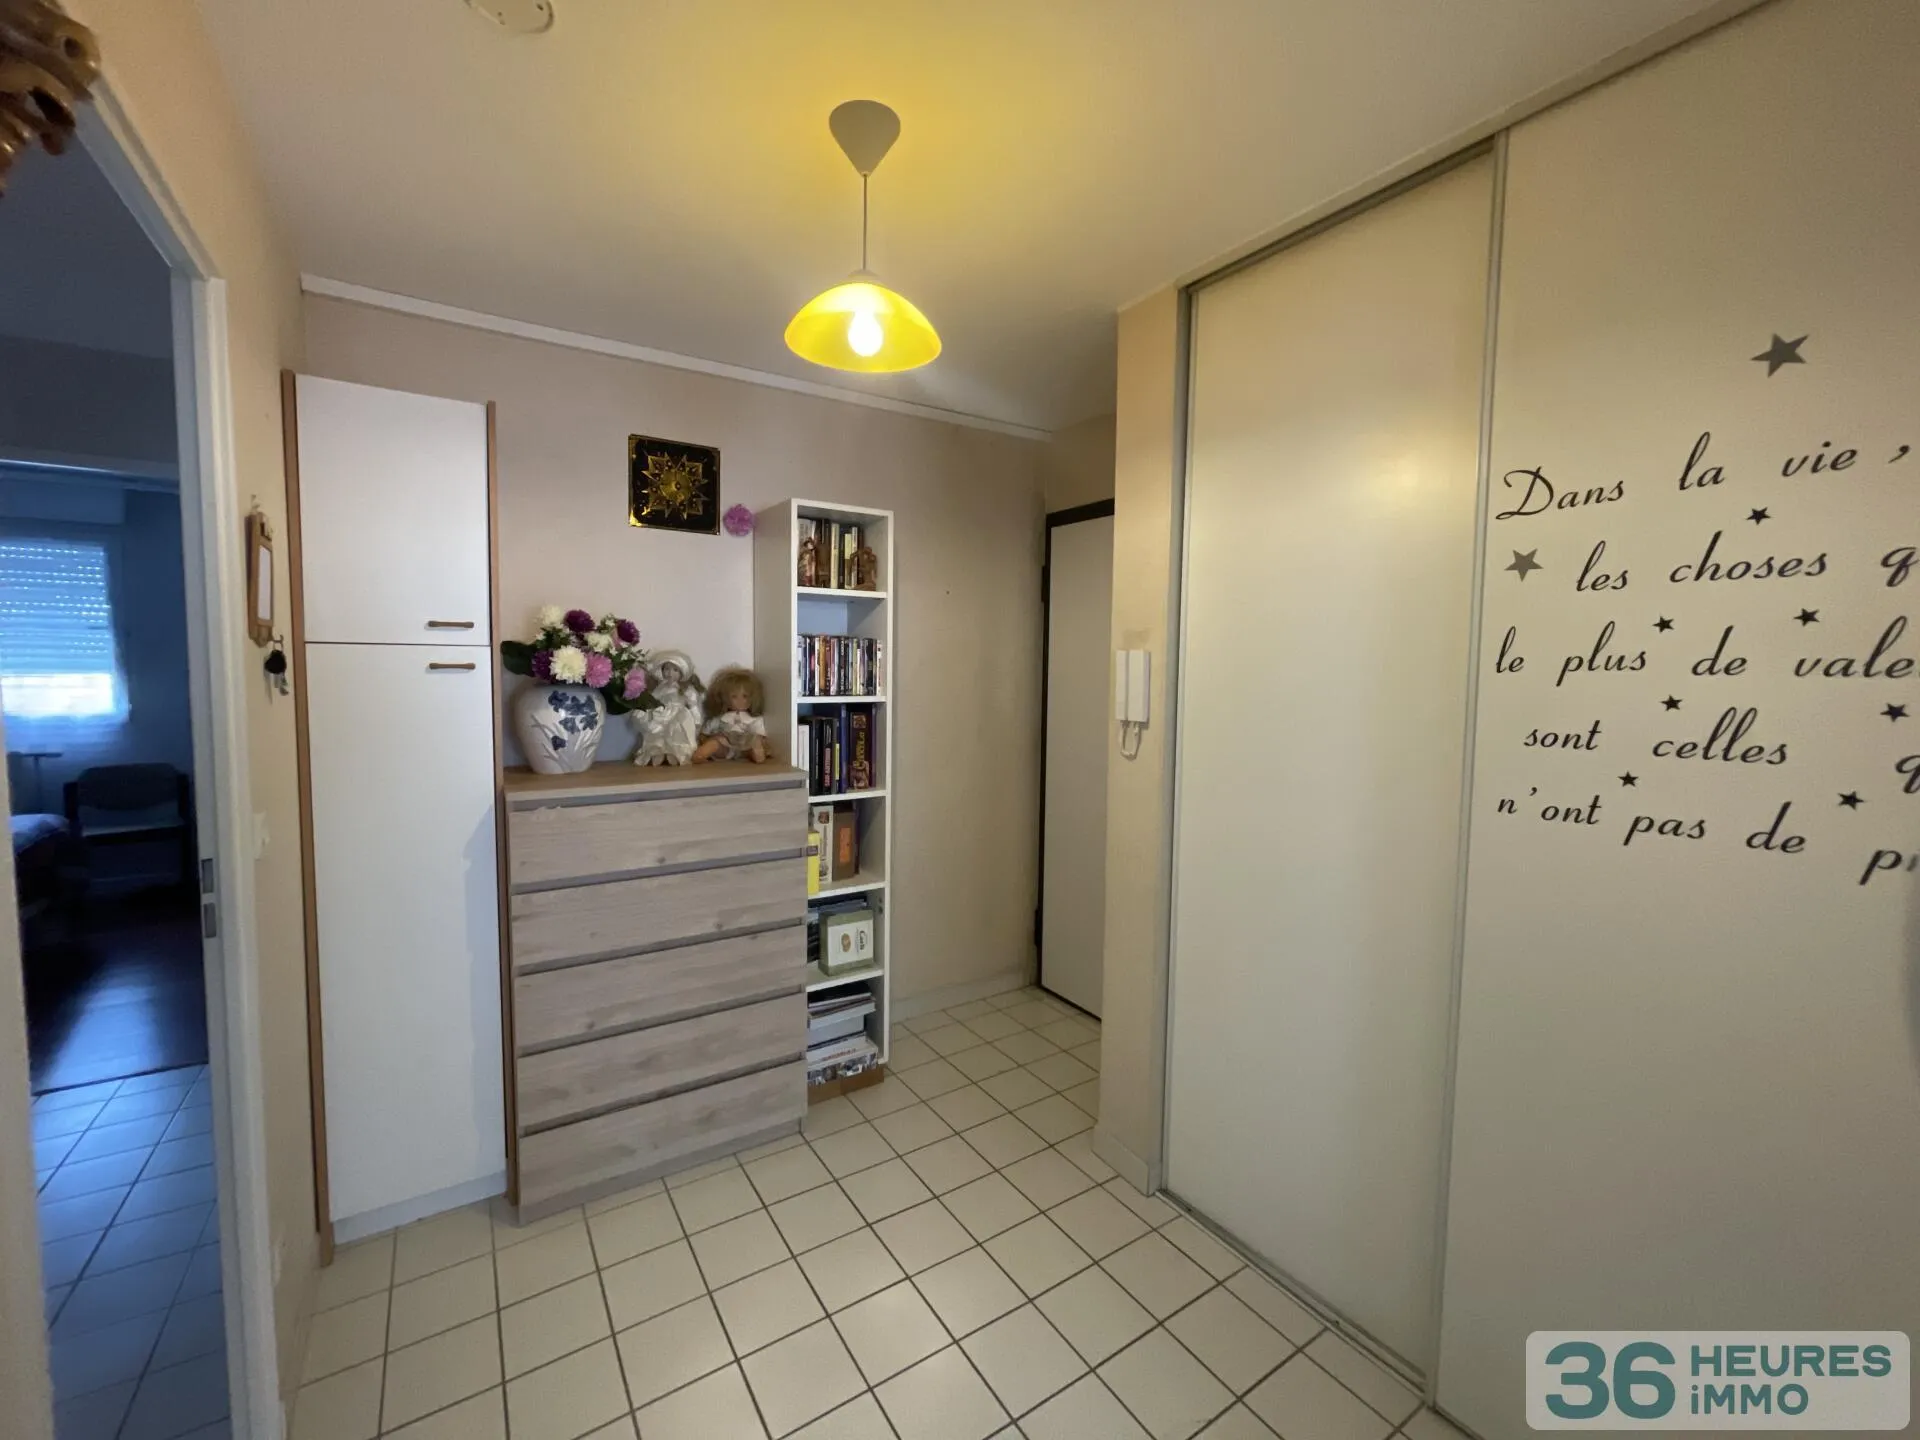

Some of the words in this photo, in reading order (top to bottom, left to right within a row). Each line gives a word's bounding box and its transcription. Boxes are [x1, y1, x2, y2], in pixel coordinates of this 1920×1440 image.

[1495, 465, 1624, 520] Dans
[1678, 431, 1725, 491] la
[1575, 539, 1629, 592] les
[1669, 529, 1828, 584] choses
[1495, 625, 1525, 674] le
[1555, 620, 1647, 688] plus
[1690, 624, 1748, 677] de
[1793, 615, 1920, 679] vale
[1523, 719, 1602, 751] sont
[1651, 706, 1788, 766] celles
[1622, 815, 1706, 847] pas
[1745, 800, 1807, 854] de
